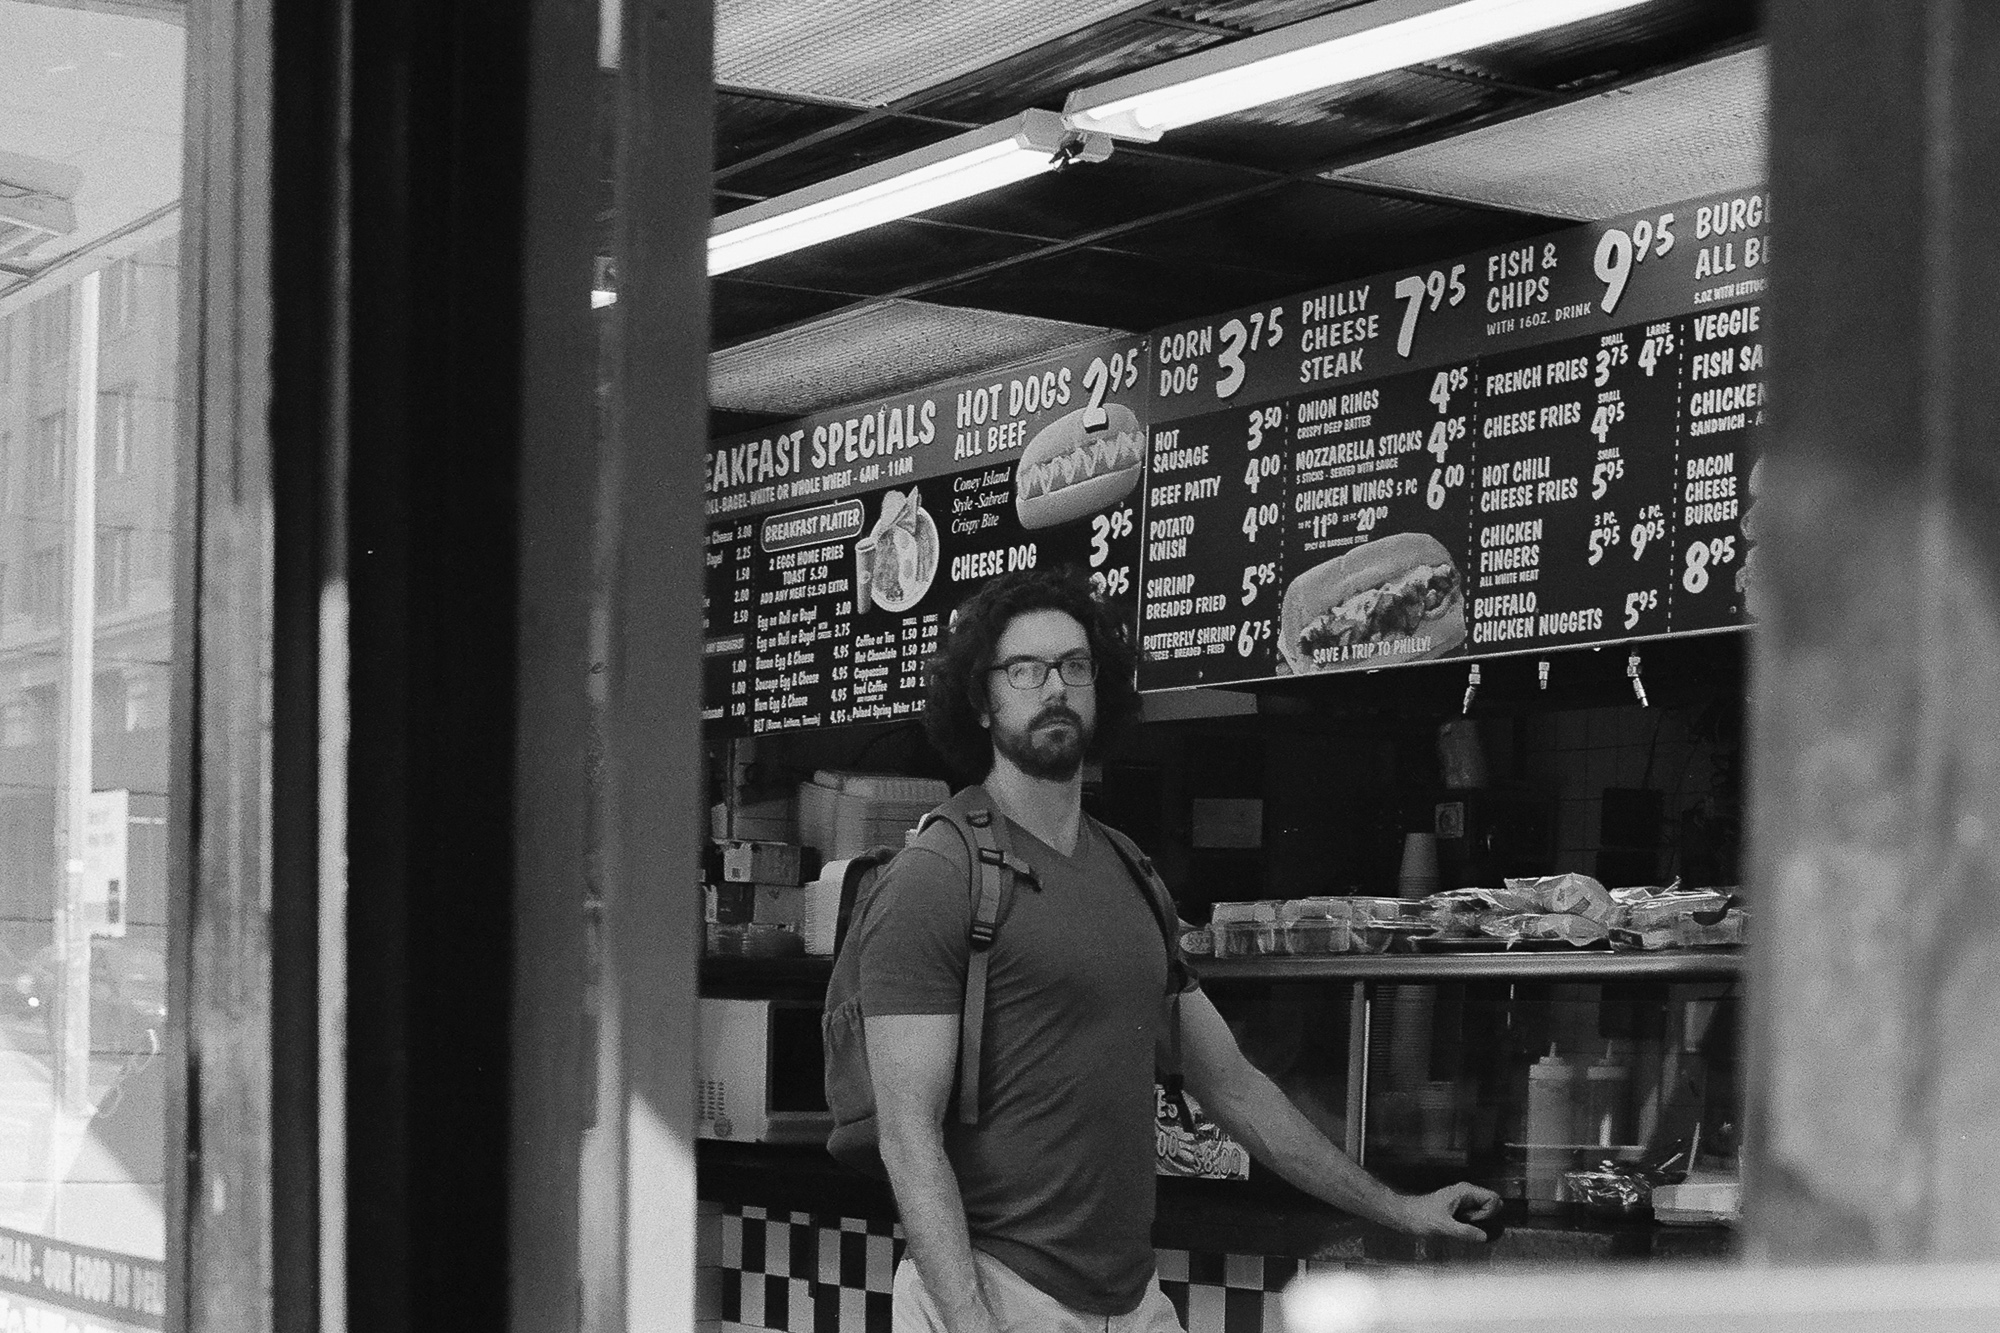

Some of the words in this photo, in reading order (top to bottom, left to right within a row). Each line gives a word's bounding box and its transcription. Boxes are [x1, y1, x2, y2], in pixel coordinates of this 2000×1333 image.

[1488, 246, 1534, 282] FISH
[1541, 242, 1558, 270] &
[1695, 243, 1736, 280] ALL
[1302, 285, 1370, 324] PHILLY
[1487, 276, 1549, 313] CHIPS
[1714, 284, 1735, 301] WITH
[1487, 319, 1514, 336] WITH
[1555, 302, 1592, 321] DRINK
[1694, 306, 1761, 342] VEGGIE
[1160, 326, 1212, 364] CORN
[1302, 314, 1379, 352] CHEESE
[1600, 333, 1624, 347] SMALL
[1646, 322, 1671, 337] LARGE
[1301, 348, 1363, 383] STEAK
[1486, 365, 1542, 397] FRENCH
[1547, 356, 1588, 385] FRIES
[1692, 348, 1734, 381] FISH
[1160, 363, 1198, 397] DOG
[957, 384, 1003, 429] HOT
[1009, 367, 1071, 417] DOGS
[1298, 397, 1337, 423] ONION
[1340, 389, 1380, 415] RINGS
[1597, 390, 1621, 404] SMALL
[1297, 424, 1322, 439] CRISPY
[1323, 420, 1343, 435] DEEP
[1483, 410, 1536, 439] CHEESE
[1540, 401, 1581, 430] FRIES
[1690, 413, 1746, 436] SANDWICH
[812, 400, 936, 468] SPECIALS
[954, 431, 982, 461] ALL
[987, 420, 1027, 453] BEEF
[1155, 429, 1180, 452] HOT
[1153, 445, 1209, 473] SAUSAGE
[1296, 439, 1375, 471] MOZZARELLA
[1378, 430, 1423, 457] STICKS
[1597, 447, 1620, 461] SMALL
[777, 484, 789, 500] OR
[791, 477, 820, 498] WHOLE
[822, 470, 852, 491] WHEAT
[860, 465, 880, 483] 6AM
[888, 456, 914, 477] 11AM
[953, 474, 982, 493] Coney
[982, 467, 1011, 487] Island
[1301, 470, 1324, 483] STICKS
[1330, 465, 1355, 479] SERVED
[1482, 463, 1510, 488] HOT
[1512, 456, 1550, 483] CHILI
[1687, 453, 1734, 480] BACON
[1151, 484, 1182, 507] BEEF
[1184, 475, 1221, 501] PATTY
[1295, 485, 1349, 512] CHICKEN
[1352, 478, 1394, 503] WINGS
[1396, 481, 1403, 496] 5
[1404, 478, 1418, 495] PC
[1480, 484, 1533, 512] CHEESE
[1537, 477, 1578, 504] FRIES
[1685, 476, 1737, 503] CHEESE
[951, 497, 973, 516] Style
[1594, 514, 1601, 526] 3
[1603, 511, 1617, 525] PC.
[1639, 507, 1646, 520] 6
[1648, 504, 1664, 518] PC.
[1685, 499, 1738, 526] BURGER
[764, 516, 818, 543] BREAKFAST
[819, 508, 860, 533] PLATTER
[951, 517, 979, 536] Crispy
[981, 513, 1000, 530] Bite
[1150, 515, 1195, 541] POTATO
[1480, 518, 1543, 548] CHICKEN
[736, 546, 751, 561] 2.25
[769, 558, 776, 571] 2
[776, 553, 796, 570] EGGS
[797, 549, 820, 566] HOME
[821, 544, 844, 562] FRIES
[951, 549, 1004, 582] CHEESE
[1008, 543, 1037, 572] DOG
[1149, 537, 1187, 562] KNISH
[1480, 544, 1539, 573] FINGERS
[783, 568, 807, 585] TOAST
[809, 565, 828, 581] 5.50
[1146, 573, 1195, 599] SHRIMP
[1479, 575, 1493, 588] ALL
[1494, 571, 1518, 586] WHITE
[1519, 569, 1540, 583] MEAT
[774, 589, 788, 603] ANY
[807, 583, 827, 598] $2.50
[828, 579, 848, 594] EXTRA
[757, 615, 769, 631] Egg
[836, 601, 852, 616] 3.00
[1146, 599, 1193, 620] BREADED
[1195, 594, 1227, 614] FRIED
[1474, 591, 1536, 619] BUFFALO
[834, 623, 850, 637] 3.75
[855, 634, 875, 648] Coffee
[901, 627, 918, 641] 1.50
[921, 625, 938, 638] 2.00
[1143, 628, 1196, 650] BUTTERFLY
[1197, 624, 1237, 645] SHRIMP
[1473, 616, 1534, 643] CHICKEN
[1538, 608, 1603, 636] NUGGETS
[775, 654, 786, 670] Egg
[793, 650, 815, 665] Cheese
[833, 644, 849, 659] 4.95
[902, 644, 918, 657] 1.50
[1313, 647, 1339, 664] SAVE
[1341, 645, 1349, 661] A
[1351, 641, 1375, 660] TRIP
[1377, 640, 1391, 657] TO
[1394, 636, 1432, 655] PHILLY!
[779, 674, 791, 691] Egg
[798, 671, 820, 685] Cheese
[831, 666, 848, 681] 4.95
[901, 660, 917, 673] 1.50
[867, 680, 888, 693] Coffee
[769, 696, 781, 713] Egg
[788, 693, 809, 708] Cheese
[830, 688, 847, 702] 4.95
[872, 704, 892, 720] Spring
[830, 709, 846, 723] 4.95
